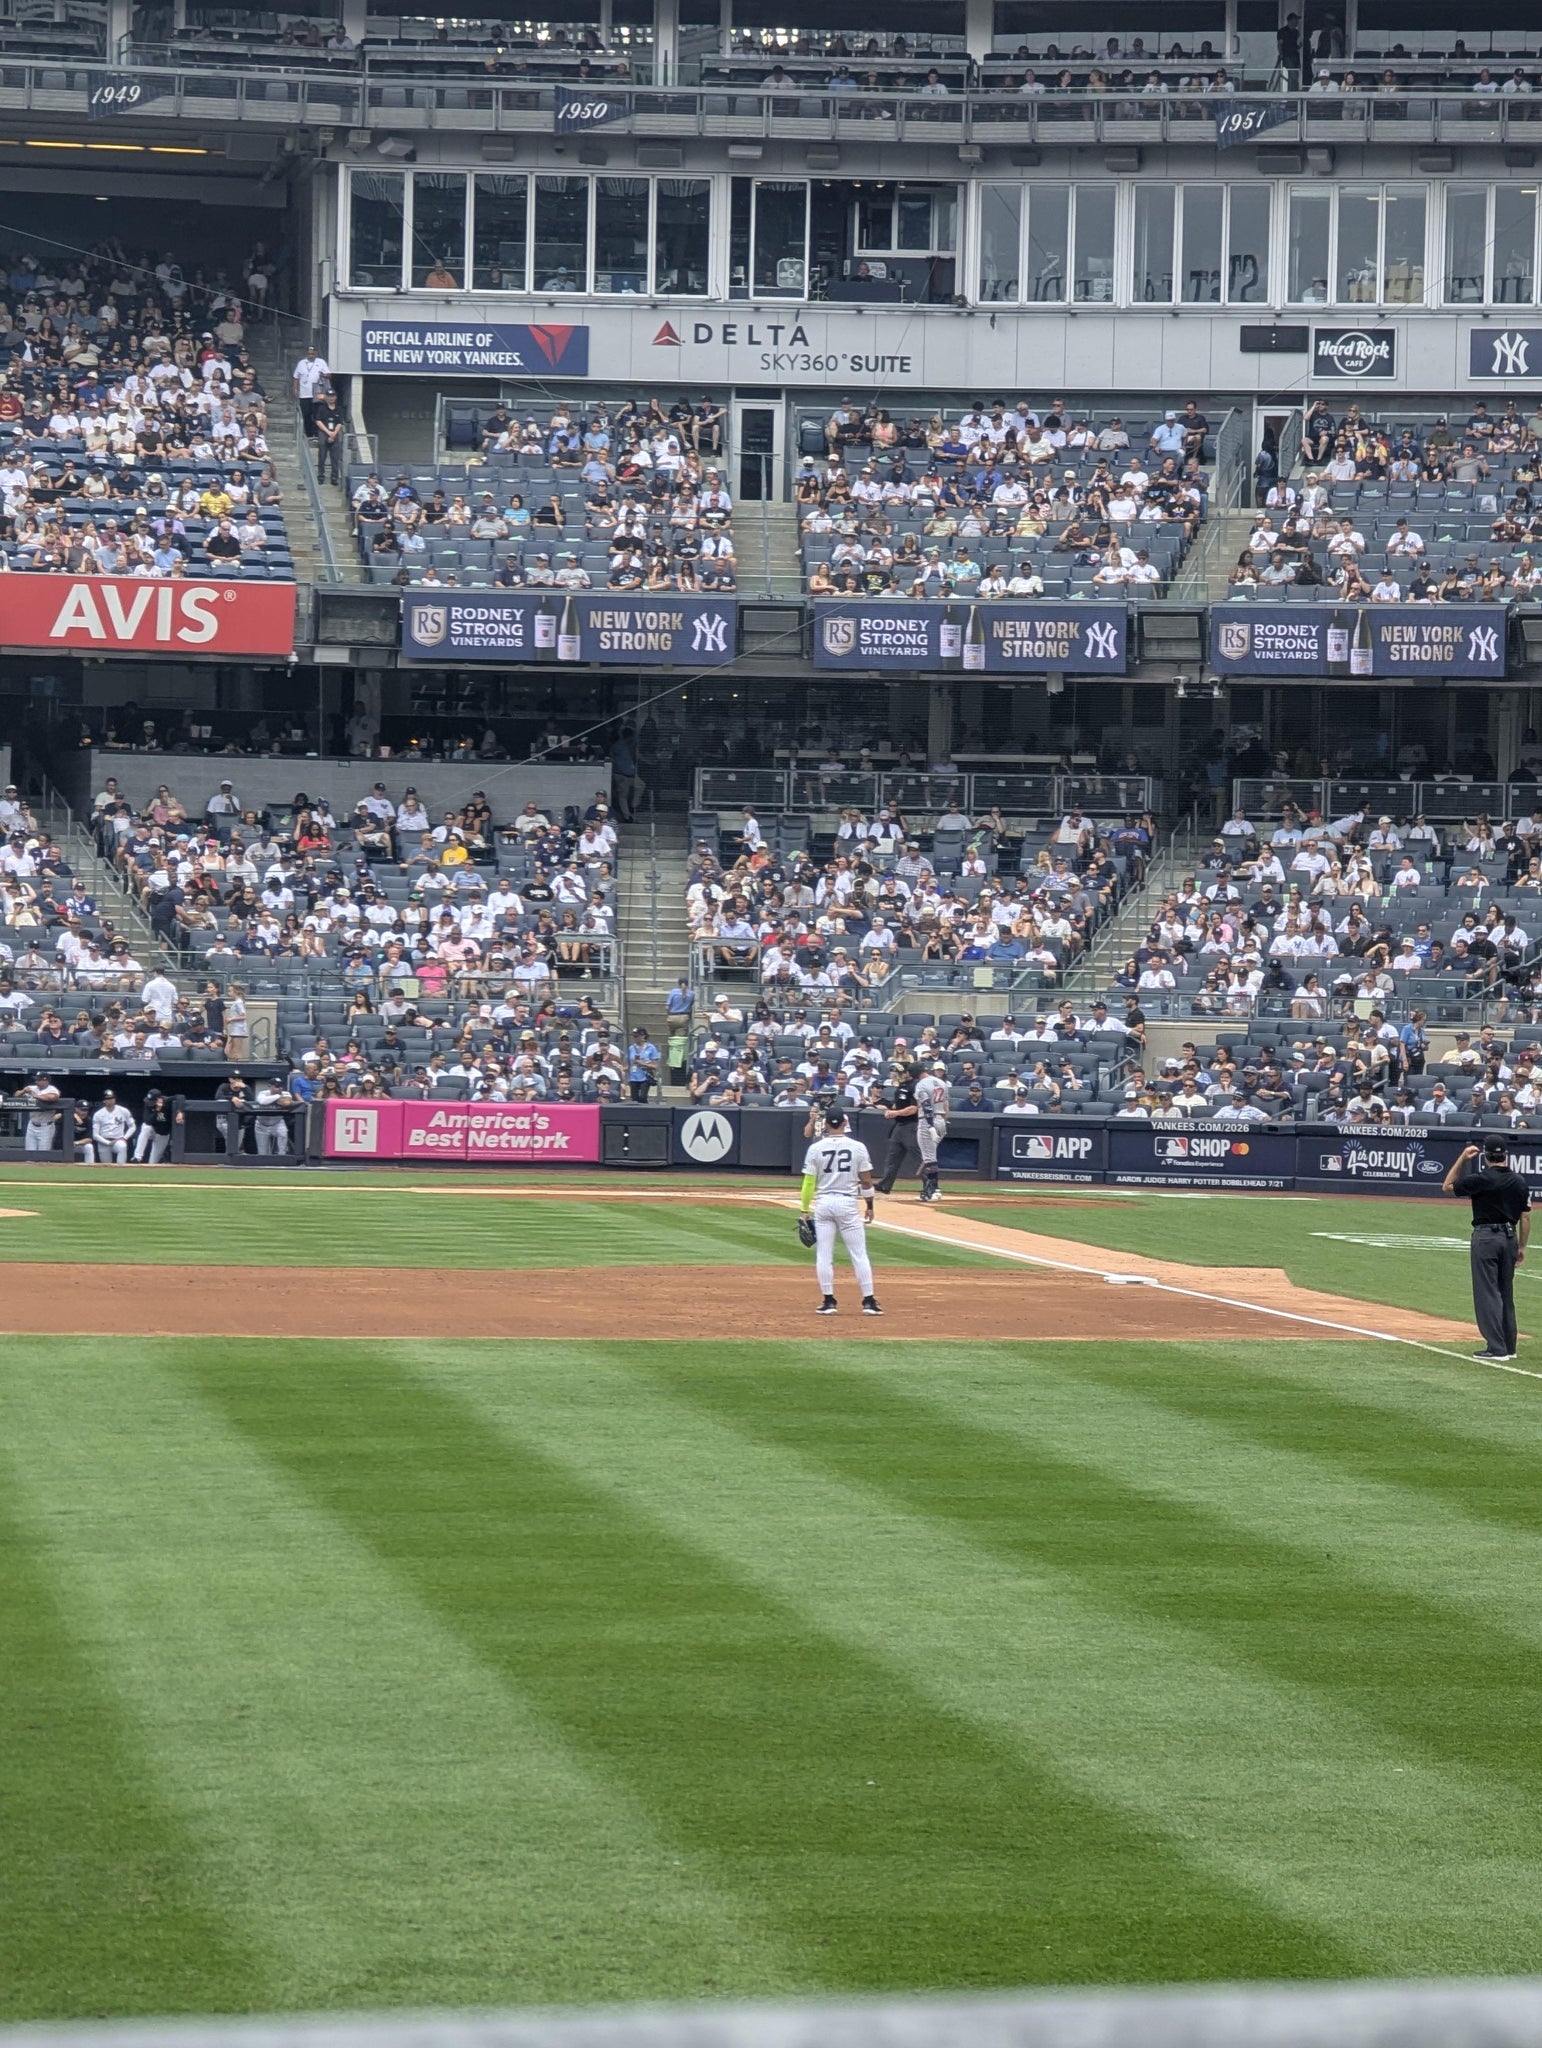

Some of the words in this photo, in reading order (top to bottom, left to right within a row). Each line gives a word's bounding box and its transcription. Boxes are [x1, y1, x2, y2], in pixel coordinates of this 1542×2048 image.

[91, 85, 141, 104] 1949
[557, 102, 608, 119] 1950
[1220, 110, 1266, 134] 1951
[366, 331, 421, 346] OFFICIAL
[424, 333, 473, 347] AIRLINE
[475, 334, 494, 347] OF
[694, 323, 810, 347] DELTA
[366, 349, 391, 363] THE
[393, 350, 425, 364] NEW
[426, 351, 461, 364] YORK
[463, 352, 524, 366] YANKEES.
[1318, 340, 1354, 357] Hard
[1355, 341, 1390, 359] Rock
[418, 611, 442, 633] RS
[451, 607, 524, 621] RODNEY
[590, 611, 631, 629] NEW
[634, 611, 683, 631] YORK
[451, 622, 524, 636] STRONG
[829, 622, 851, 643] RS
[860, 619, 930, 631] RODNEY
[993, 621, 1030, 638] NEW
[1034, 621, 1080, 639] YORK
[1254, 624, 1319, 636] RODNEY
[451, 638, 524, 647] VINEYARDS
[600, 632, 672, 651] STRONG
[860, 633, 928, 645] STRONG
[1225, 628, 1246, 648] RS
[1381, 626, 1417, 642] NEW
[1421, 626, 1463, 643] YORK
[860, 647, 928, 656] VINEYARDS
[1002, 641, 1070, 658] STRONG
[1254, 637, 1319, 650] STRONG
[1255, 651, 1319, 660] VINEYARDS
[1390, 644, 1454, 661] STRONG
[429, 1111, 549, 1130] America's
[1151, 1121, 1250, 1133] YANKEES.COM/2026
[409, 1129, 463, 1147] Best
[467, 1130, 571, 1149] Network
[1337, 1125, 1428, 1138] YANKEES.COM/2026
[1055, 1137, 1093, 1159] APP
[1190, 1138, 1231, 1157] SHOP
[821, 1149, 853, 1174] 72
[1347, 1149, 1369, 1175] 4th
[1368, 1150, 1385, 1168] OF
[1384, 1151, 1416, 1178] JULY
[1421, 1161, 1439, 1172] Ford
[1012, 1171, 1093, 1182] YANKEESBEISBOL.COM
[1116, 1175, 1142, 1183] AARON
[1143, 1176, 1166, 1184] JUDGE
[1168, 1177, 1191, 1185] HARRY
[1193, 1178, 1220, 1186] POTTER
[1221, 1179, 1267, 1187] BOBBLEHEAD
[1268, 1180, 1284, 1188] 7/21
